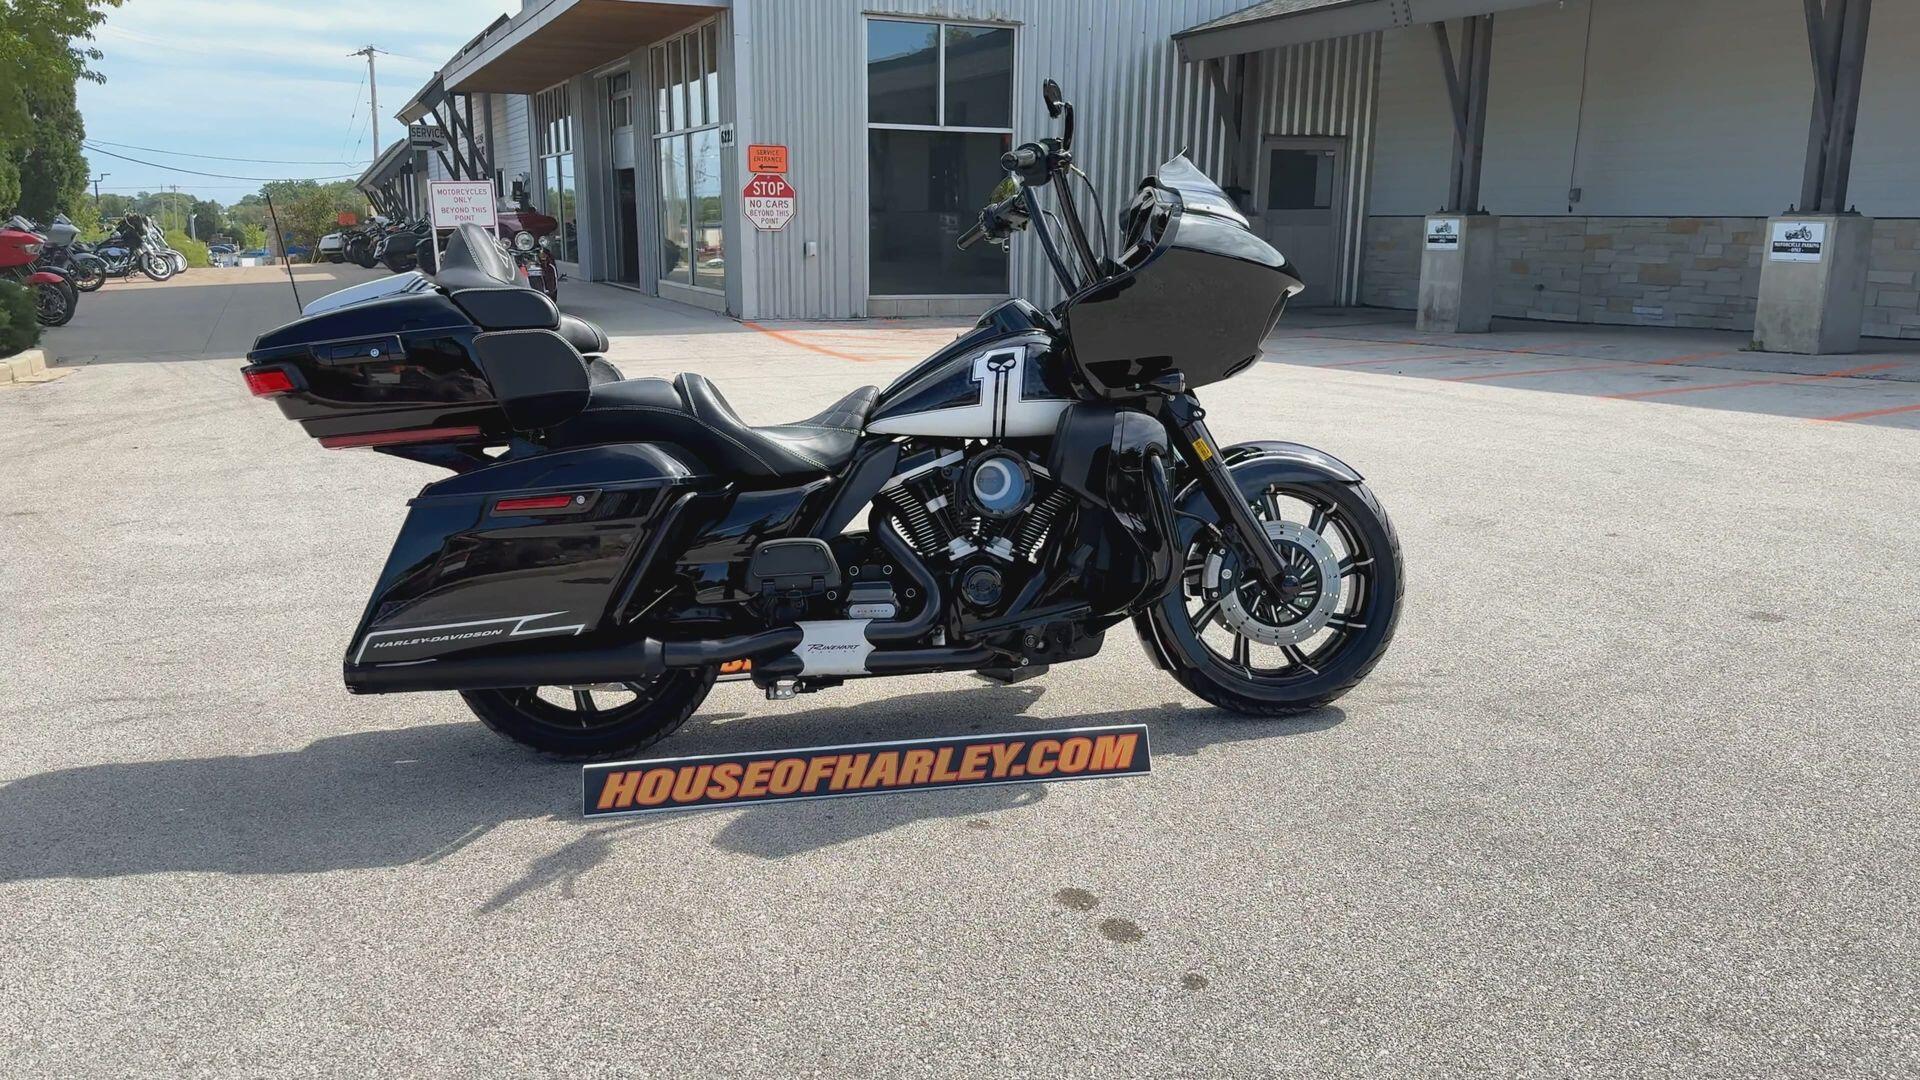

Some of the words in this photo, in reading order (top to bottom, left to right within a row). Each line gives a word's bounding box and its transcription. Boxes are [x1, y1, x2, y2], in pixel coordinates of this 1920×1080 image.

[437, 188, 488, 196] MOTORCYCLES
[753, 181, 785, 196] STOP
[454, 196, 472, 204] ONLY
[749, 200, 761, 208] NO
[766, 200, 789, 208] CARS
[441, 206, 470, 214] BEYOND
[472, 206, 487, 214] THIS
[749, 209, 774, 217] BEYOND
[776, 209, 790, 217] THIS
[760, 217, 779, 225] POINT
[373, 629, 503, 649] HARLEY-DAVIDSON
[807, 643, 860, 652] RINEHART
[597, 733, 1140, 810] HOUSEOFHARLEY.COM
